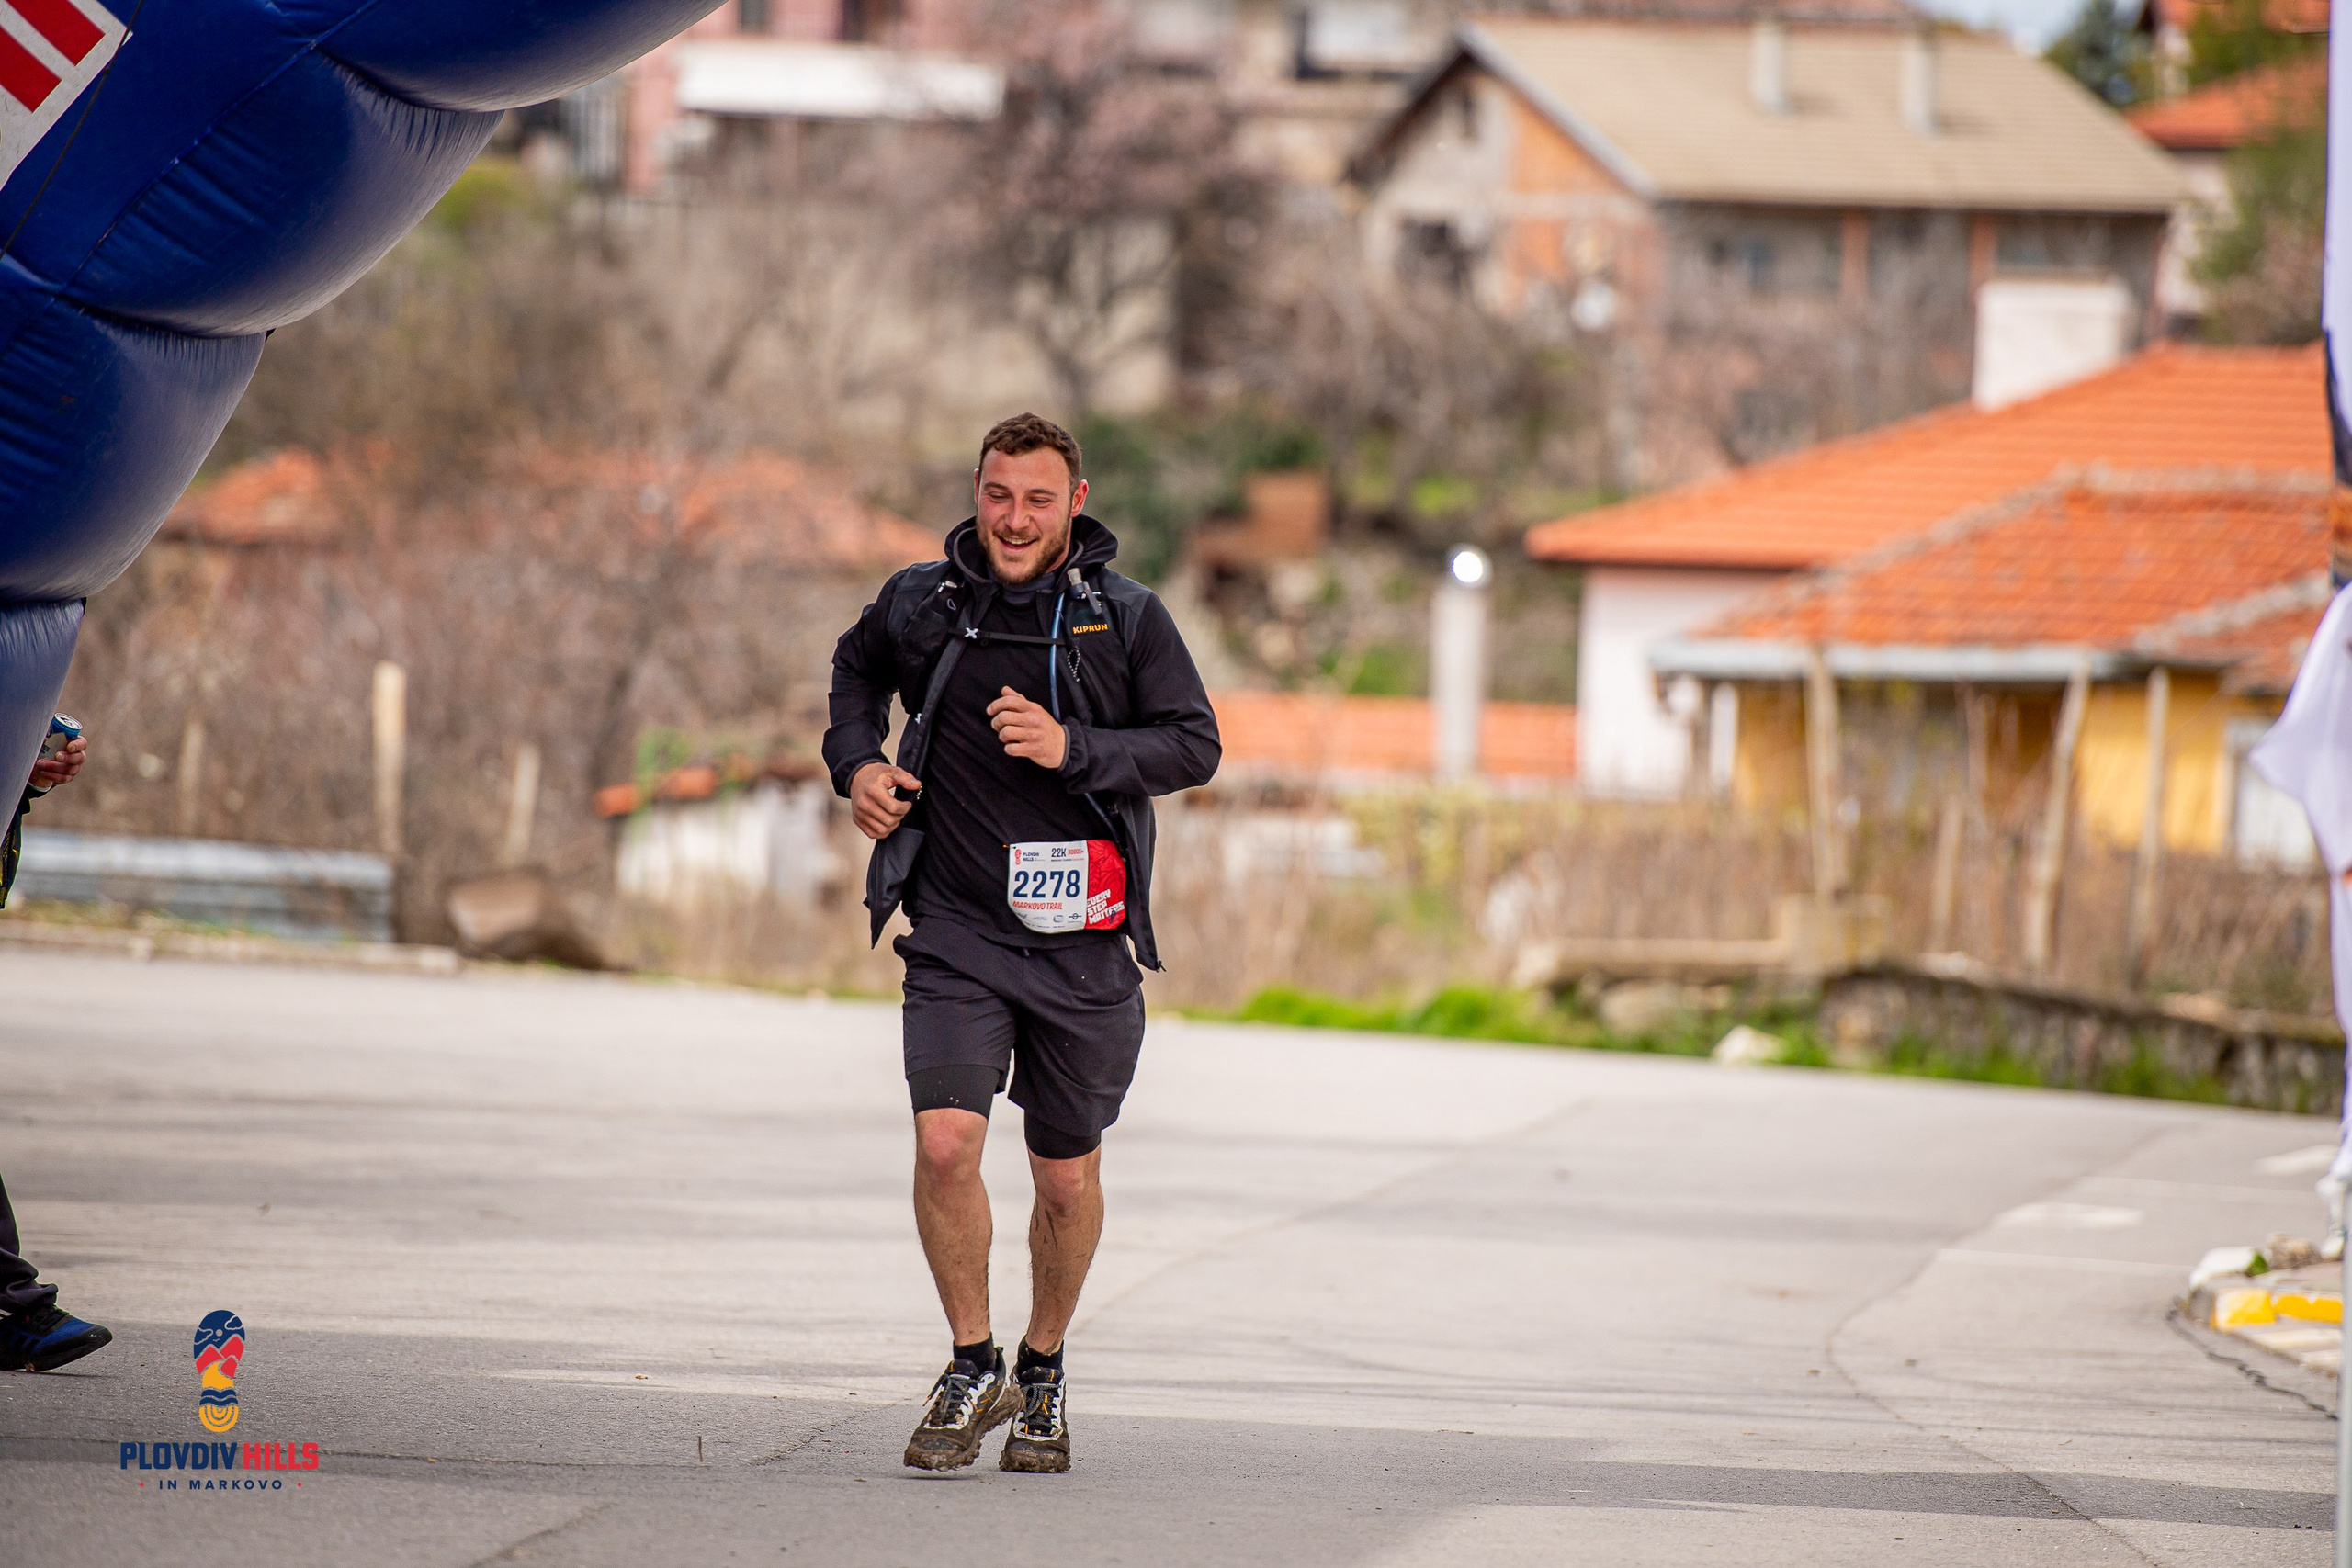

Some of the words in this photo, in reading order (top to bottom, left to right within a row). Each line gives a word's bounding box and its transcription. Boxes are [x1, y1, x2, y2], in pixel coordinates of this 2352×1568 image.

[1072, 624, 1108, 635] KIPRUN
[1051, 847, 1067, 858] 22K
[1012, 869, 1080, 898] 2278
[1012, 900, 1046, 910] MARKOVO
[1046, 901, 1063, 910] TRAIL
[1087, 900, 1108, 917] STEP
